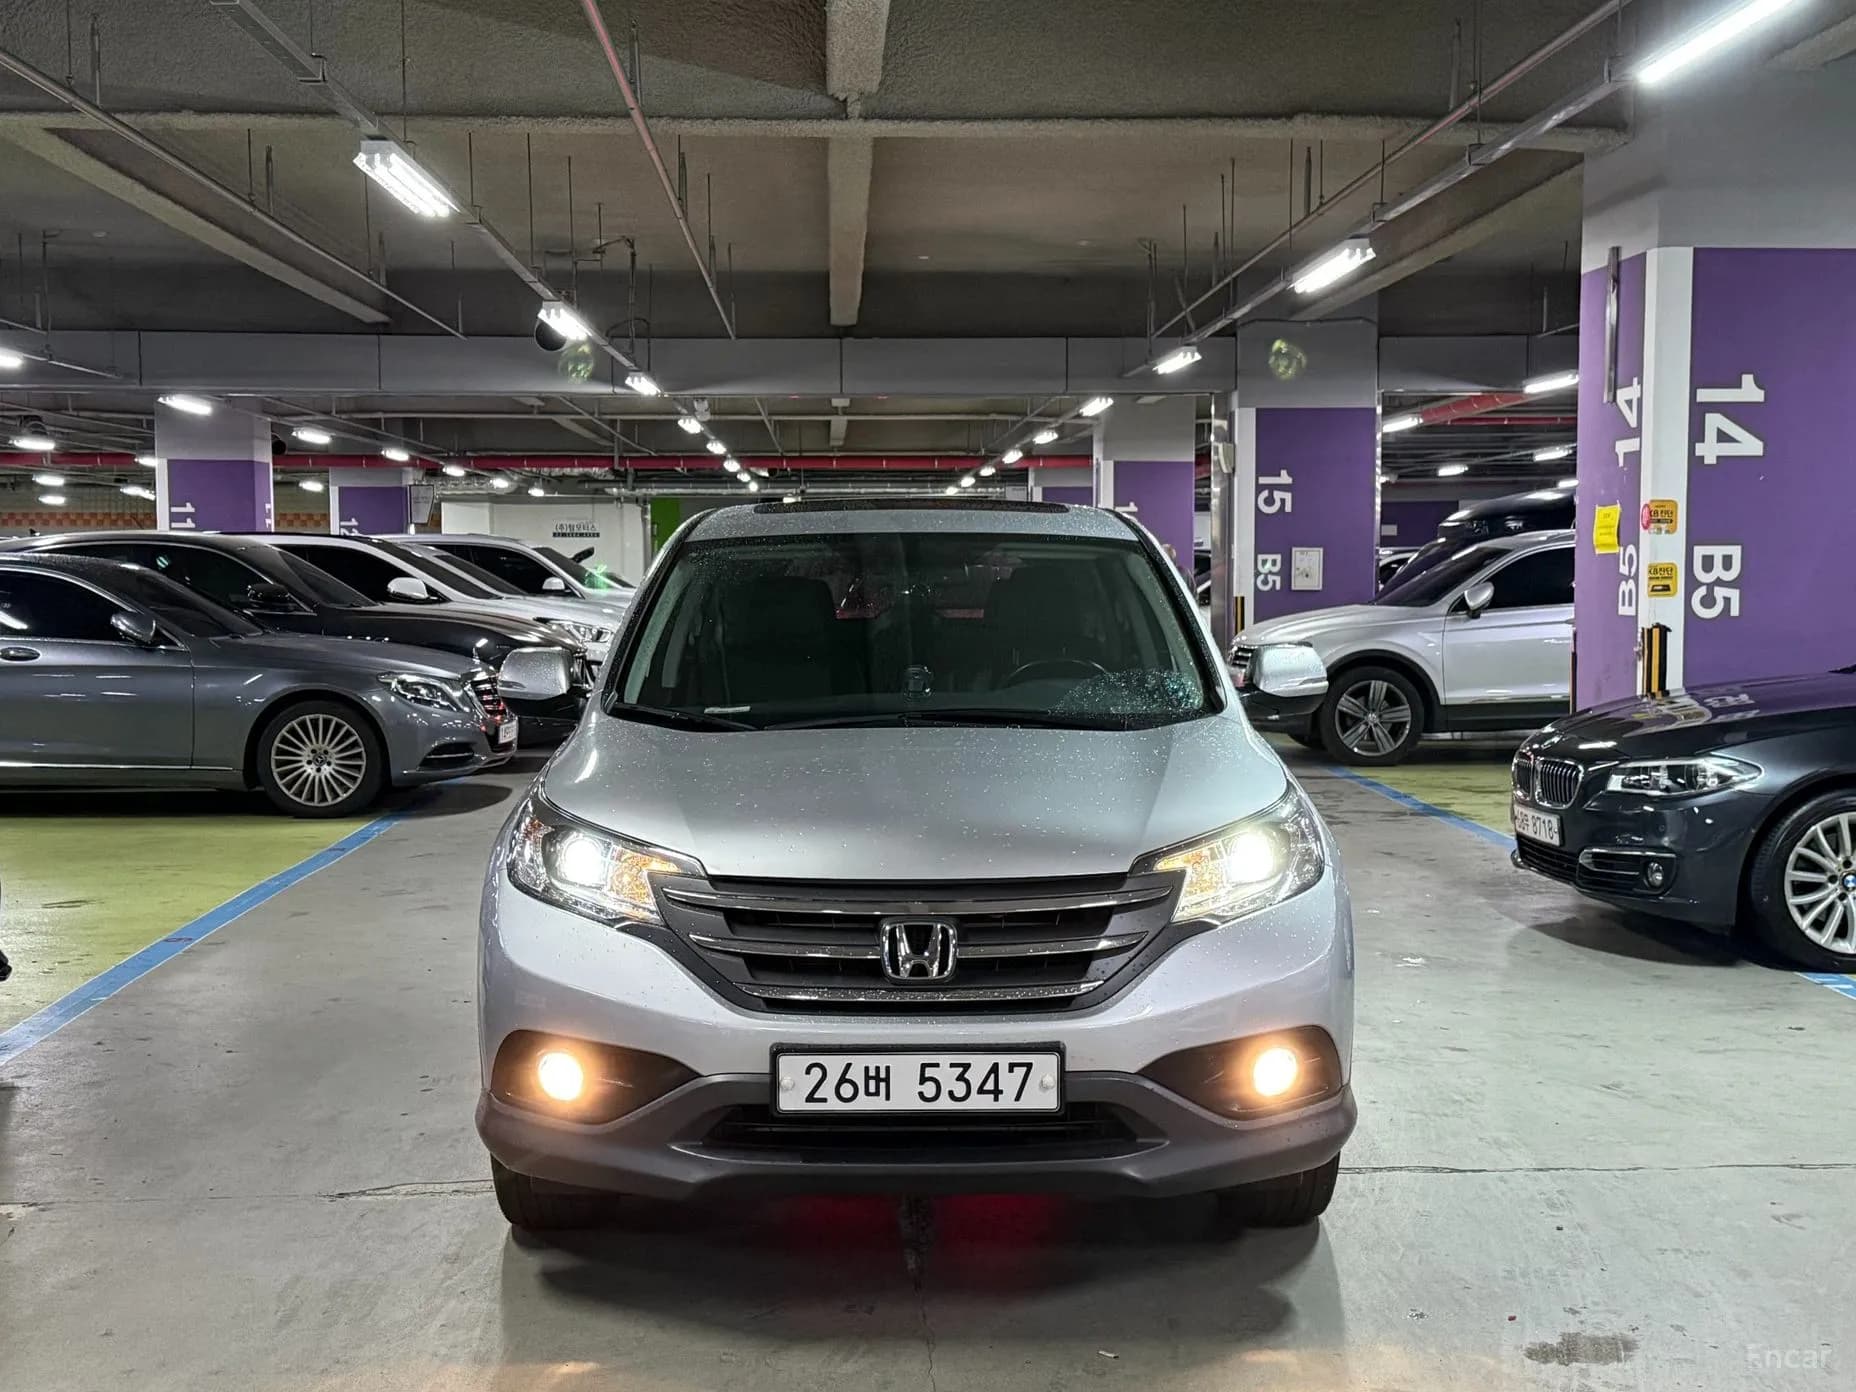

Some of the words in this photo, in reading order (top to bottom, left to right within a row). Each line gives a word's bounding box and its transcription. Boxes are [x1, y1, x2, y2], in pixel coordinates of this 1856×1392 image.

[1615, 376, 1642, 469] 14
[1694, 373, 1766, 465] 14
[1257, 469, 1293, 514] 15
[170, 502, 196, 529] 11
[1256, 553, 1282, 591] B5
[1618, 543, 1638, 617] B5
[1690, 544, 1743, 620] B5
[1531, 815, 1554, 840] 8718
[804, 1062, 891, 1104] 26버
[917, 1062, 1034, 1103] 5347
